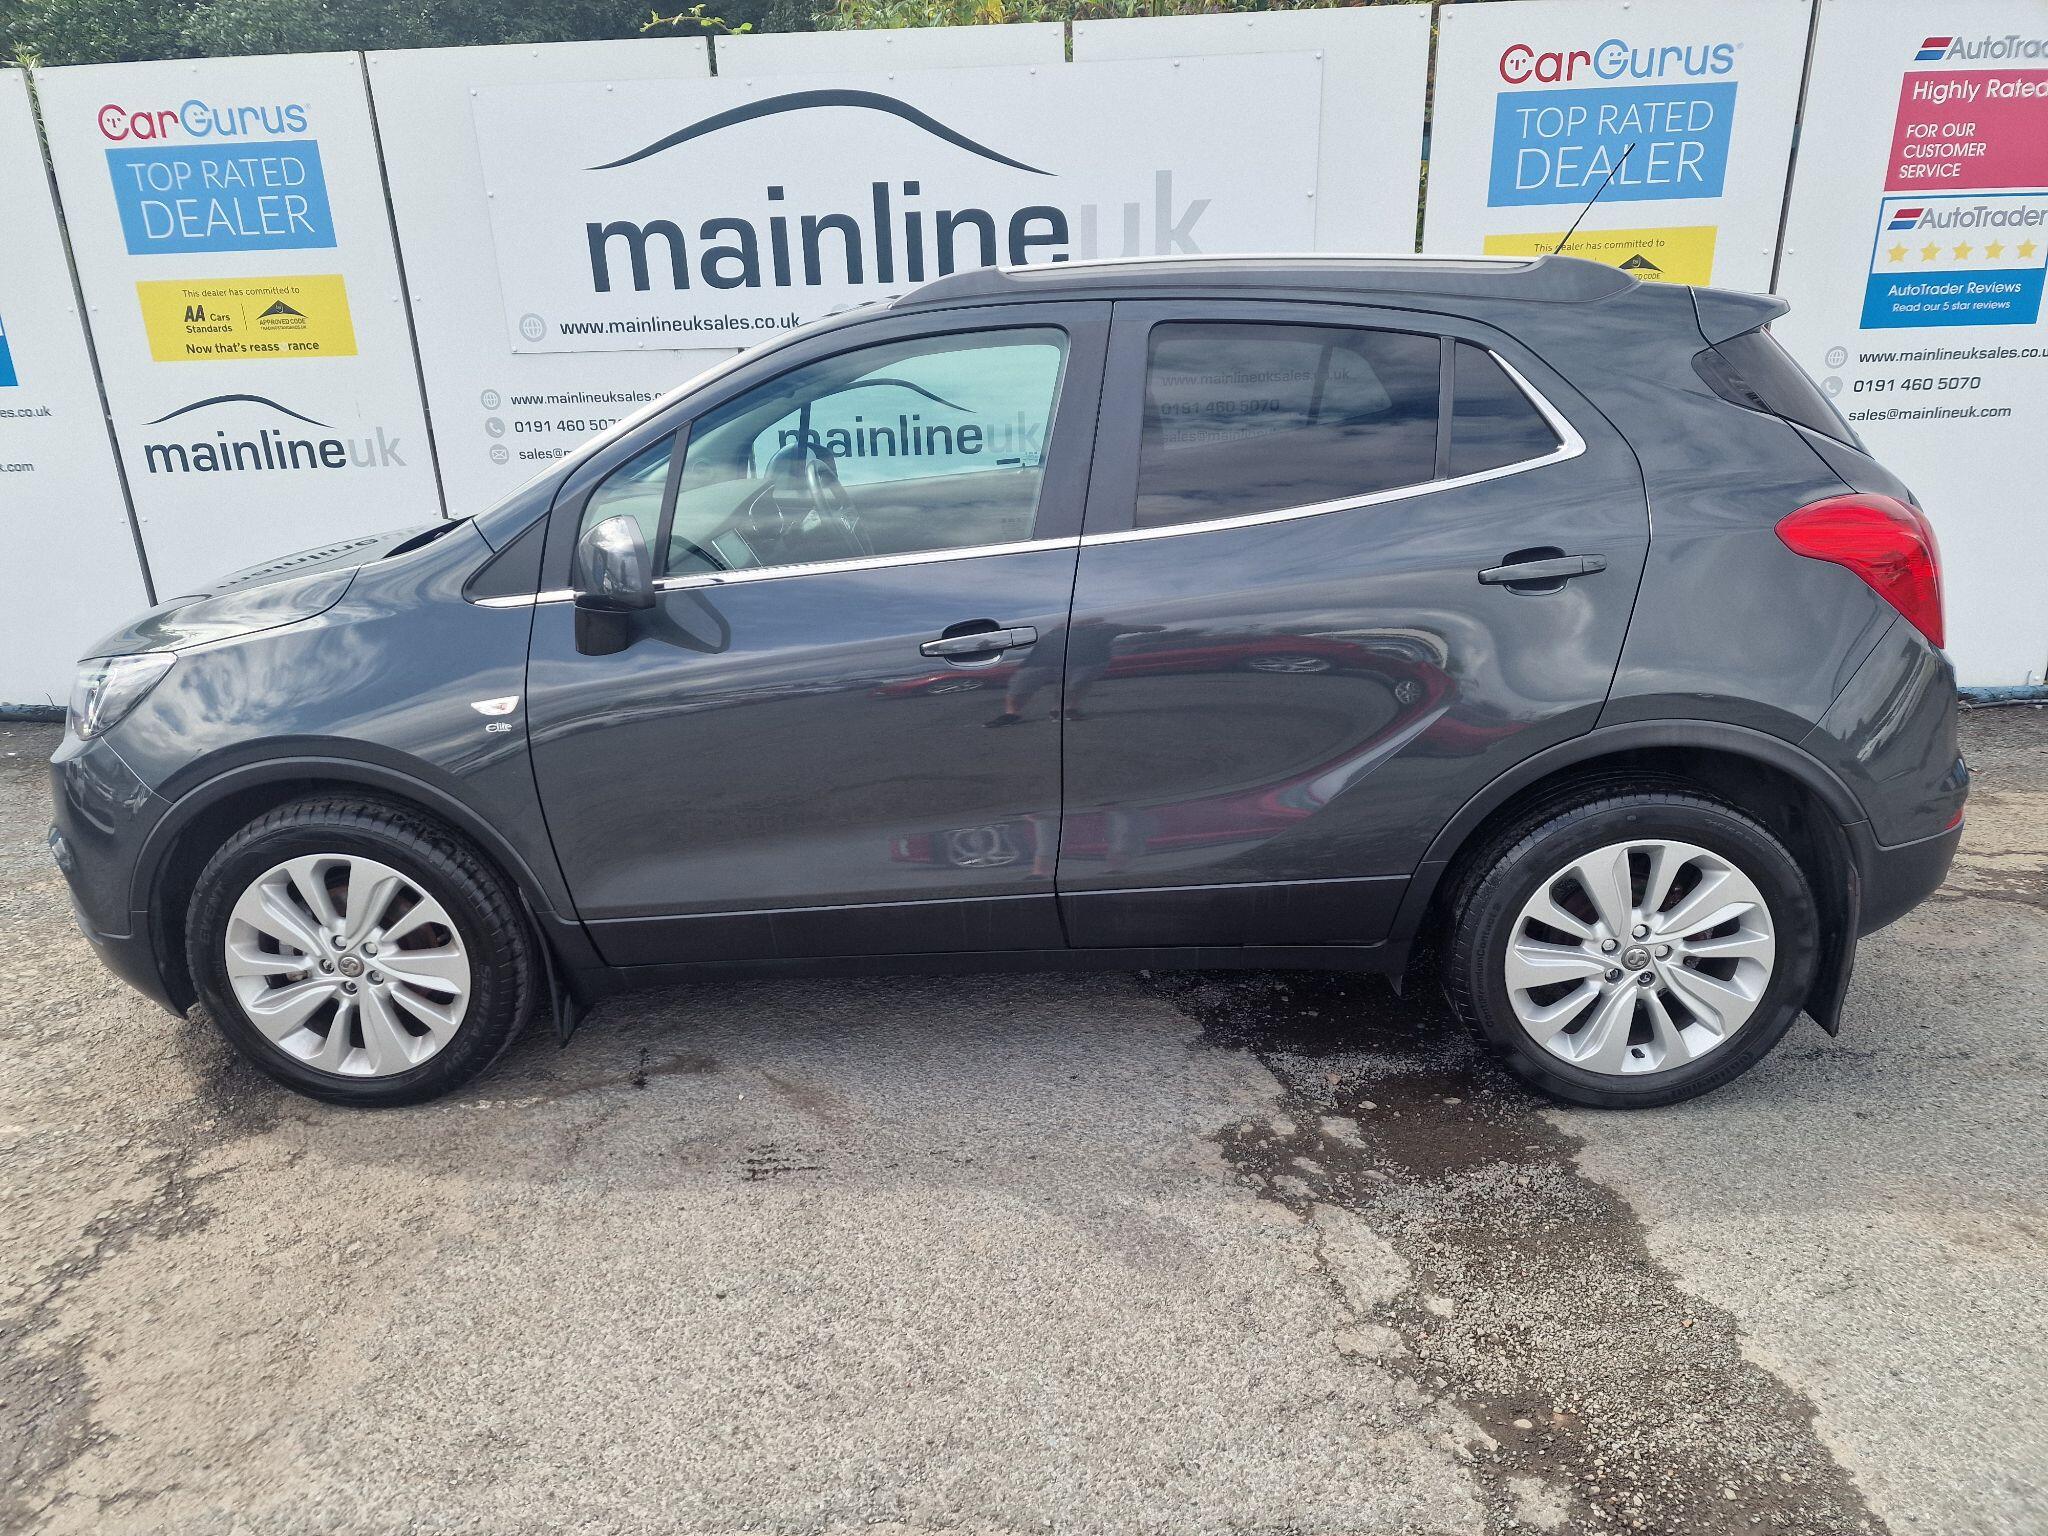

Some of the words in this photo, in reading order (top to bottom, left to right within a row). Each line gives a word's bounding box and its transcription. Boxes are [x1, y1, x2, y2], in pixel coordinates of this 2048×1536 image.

[1499, 38, 1734, 85] CarGurus
[1912, 79, 1981, 105] Highly
[97, 99, 308, 141] CarGurus
[1516, 106, 1587, 139] TOP
[1597, 100, 1714, 136] RATED
[1906, 124, 1938, 138] FOR
[1942, 122, 1976, 138] OUR
[1903, 142, 1987, 159] CUSTOMER
[1515, 141, 1705, 190] DEALER
[1899, 163, 1962, 179] SERVICE
[126, 161, 192, 192] TOP
[201, 157, 306, 190] RATED
[139, 194, 315, 239] DEALER
[1917, 205, 2048, 230] AutoTrader
[1534, 243, 1553, 252] This
[1586, 241, 1602, 250] has
[1604, 239, 1653, 249] committed
[1656, 239, 1665, 247] to
[182, 289, 200, 298] This
[201, 288, 227, 297] dealer
[229, 288, 243, 296] has
[245, 286, 289, 296] committed
[1888, 282, 1964, 297] AutoTrader
[1967, 281, 2022, 294] Reviews
[184, 304, 205, 323] AA
[210, 313, 231, 322] Cars
[1892, 302, 1921, 313] Read
[1924, 303, 1940, 312] our
[1943, 302, 1949, 311] 5
[1952, 301, 1971, 310] star
[1973, 300, 2011, 310] reviews
[186, 324, 233, 334] Standards
[560, 312, 800, 335] www.mainlineuksales.co.uk
[186, 343, 212, 354] Now
[215, 342, 247, 354] that's
[249, 341, 320, 352] reassrance
[1853, 379, 1895, 393] 0191
[1900, 378, 1934, 391] 460
[1937, 376, 1982, 390] 5070
[1848, 405, 2012, 421] sales@mainlineuk.com
[514, 420, 551, 433] 0191
[557, 419, 585, 432] 460
[589, 418, 623, 431] 507
[144, 427, 407, 474] mainlineuk
